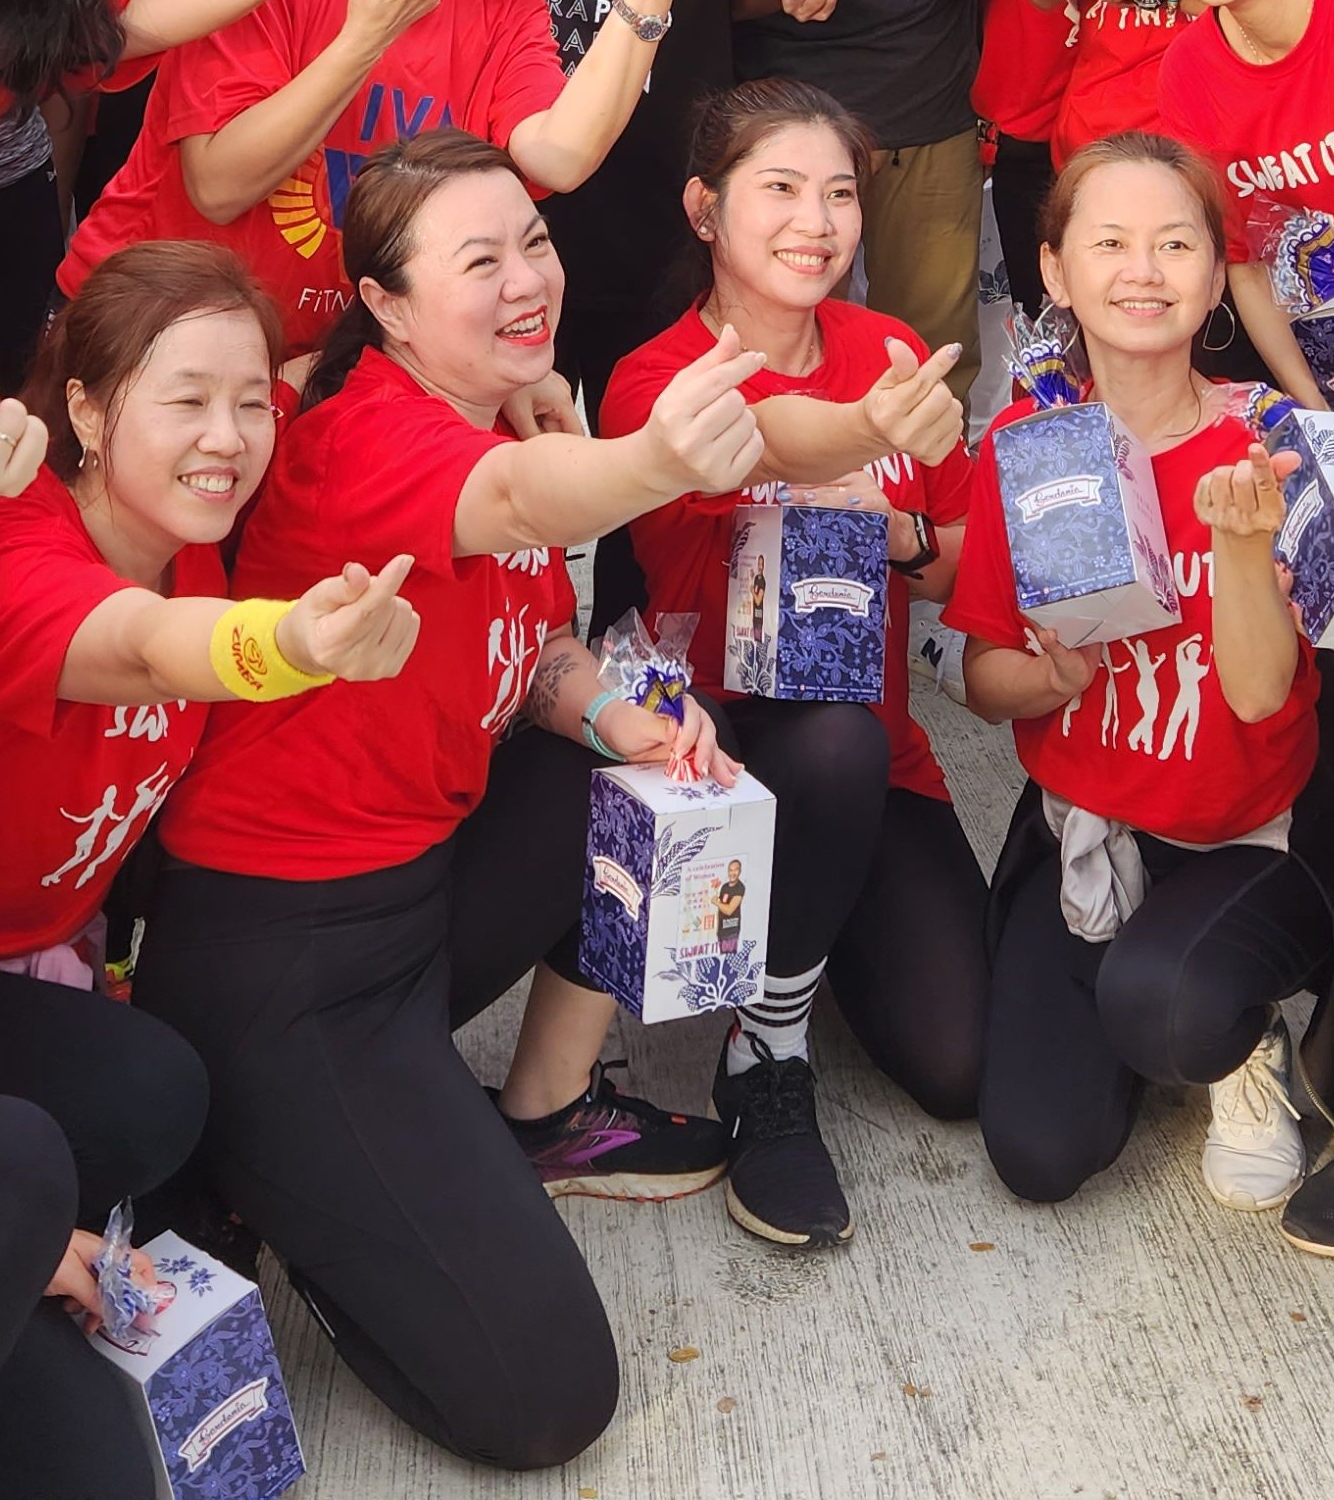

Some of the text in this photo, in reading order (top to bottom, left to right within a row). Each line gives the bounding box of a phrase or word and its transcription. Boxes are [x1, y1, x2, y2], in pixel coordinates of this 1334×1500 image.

[1227, 143, 1320, 198] SWEAT
[1033, 484, 1084, 507] Gardenia
[808, 584, 857, 602] Gardenia
[232, 624, 264, 691] ZUMBA
[680, 942, 710, 959] SWEAT
[198, 1400, 249, 1446] Gardenia
